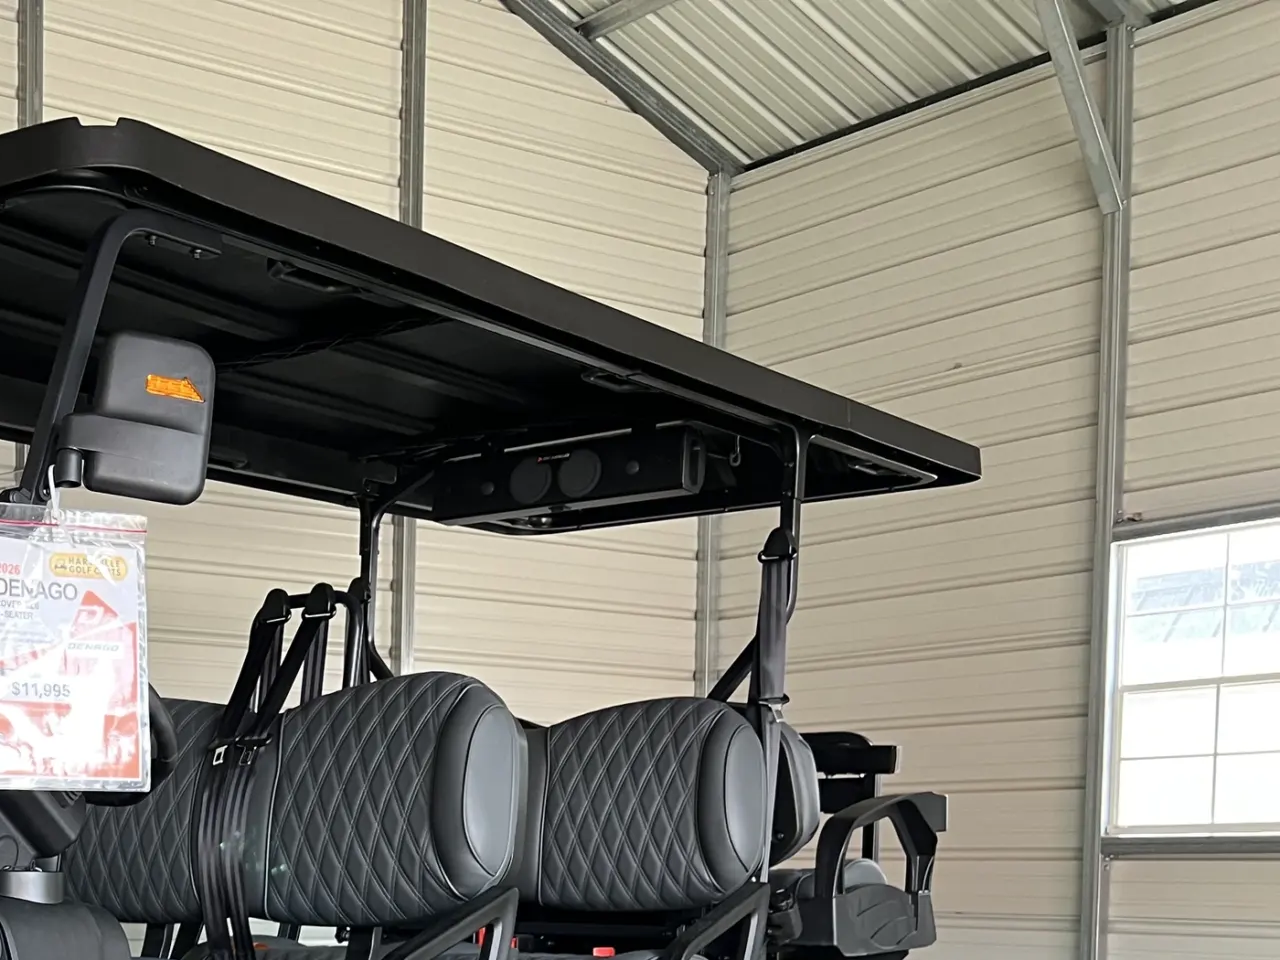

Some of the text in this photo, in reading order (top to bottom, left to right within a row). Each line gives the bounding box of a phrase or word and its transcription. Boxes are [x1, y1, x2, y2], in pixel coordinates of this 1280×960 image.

[68, 557, 121, 568] HARILLE
[68, 565, 121, 577] GOLF CTS
[67, 642, 120, 652] DENAGO
[11, 681, 71, 699] $11,995
